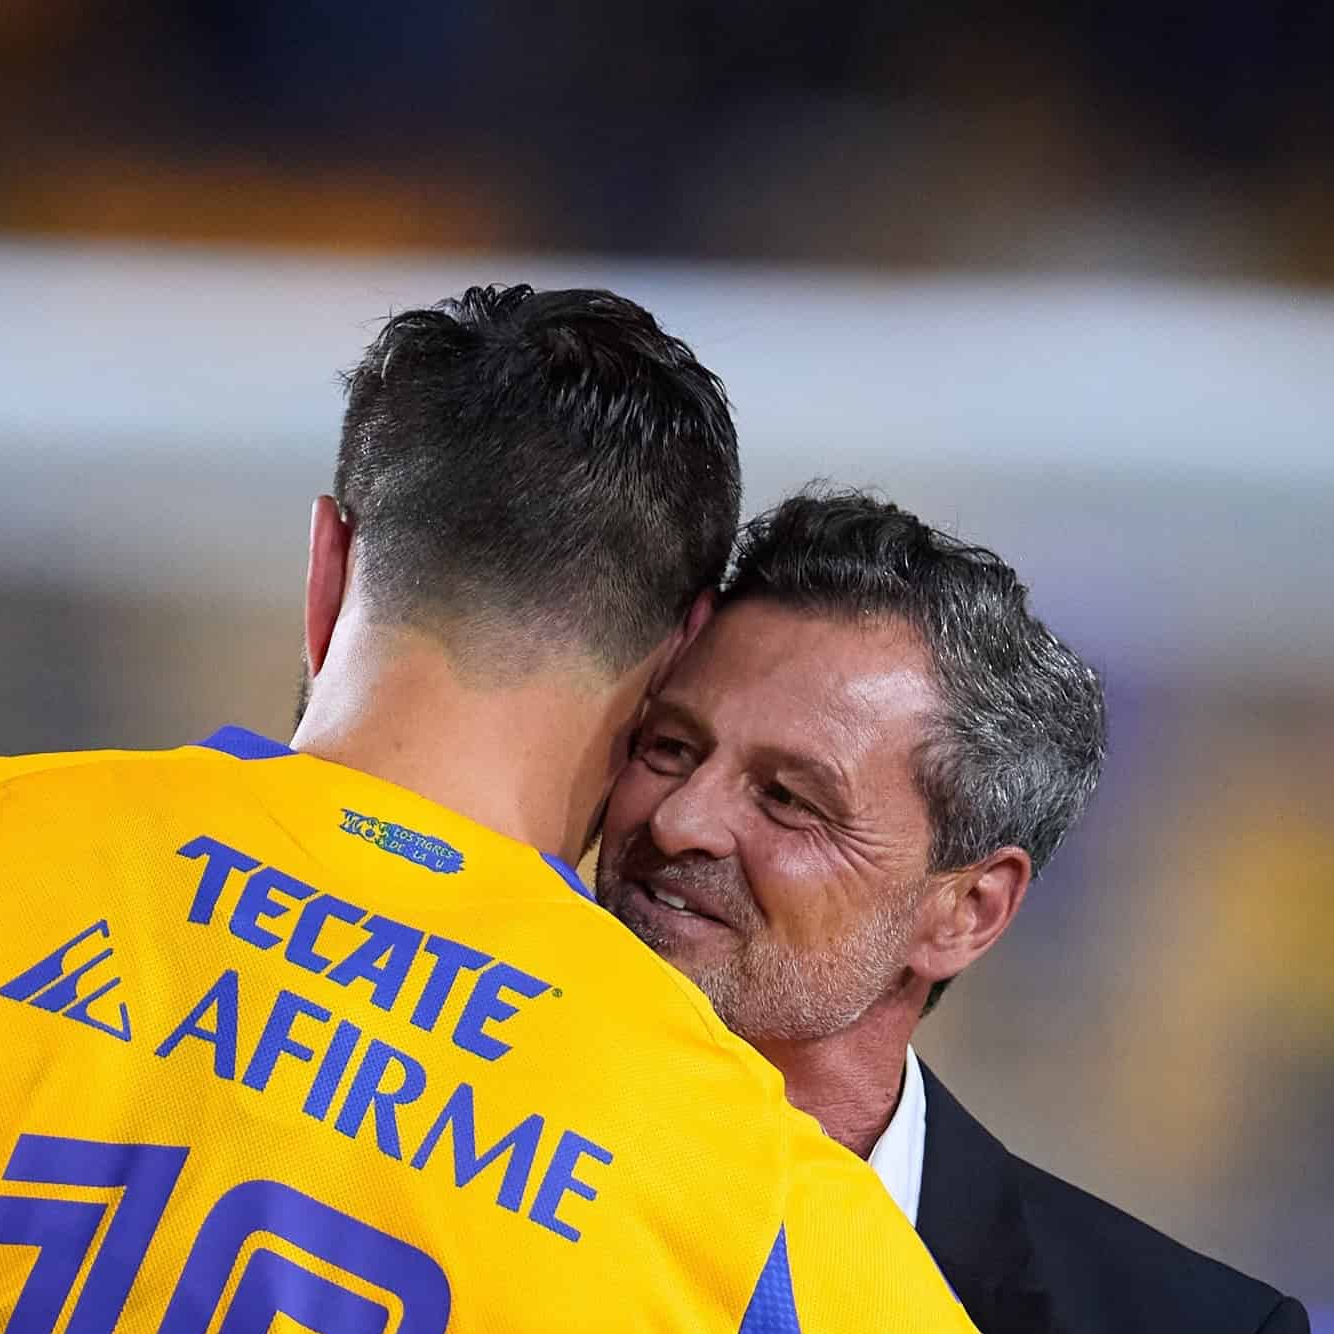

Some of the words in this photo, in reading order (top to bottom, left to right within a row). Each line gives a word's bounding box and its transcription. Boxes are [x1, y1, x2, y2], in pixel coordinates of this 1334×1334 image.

[394, 828, 414, 842] LOS
[414, 837, 455, 859] TIGRES
[413, 851, 427, 862] LA
[176, 835, 553, 1061] TECATE
[155, 968, 614, 1243] AFIRME
